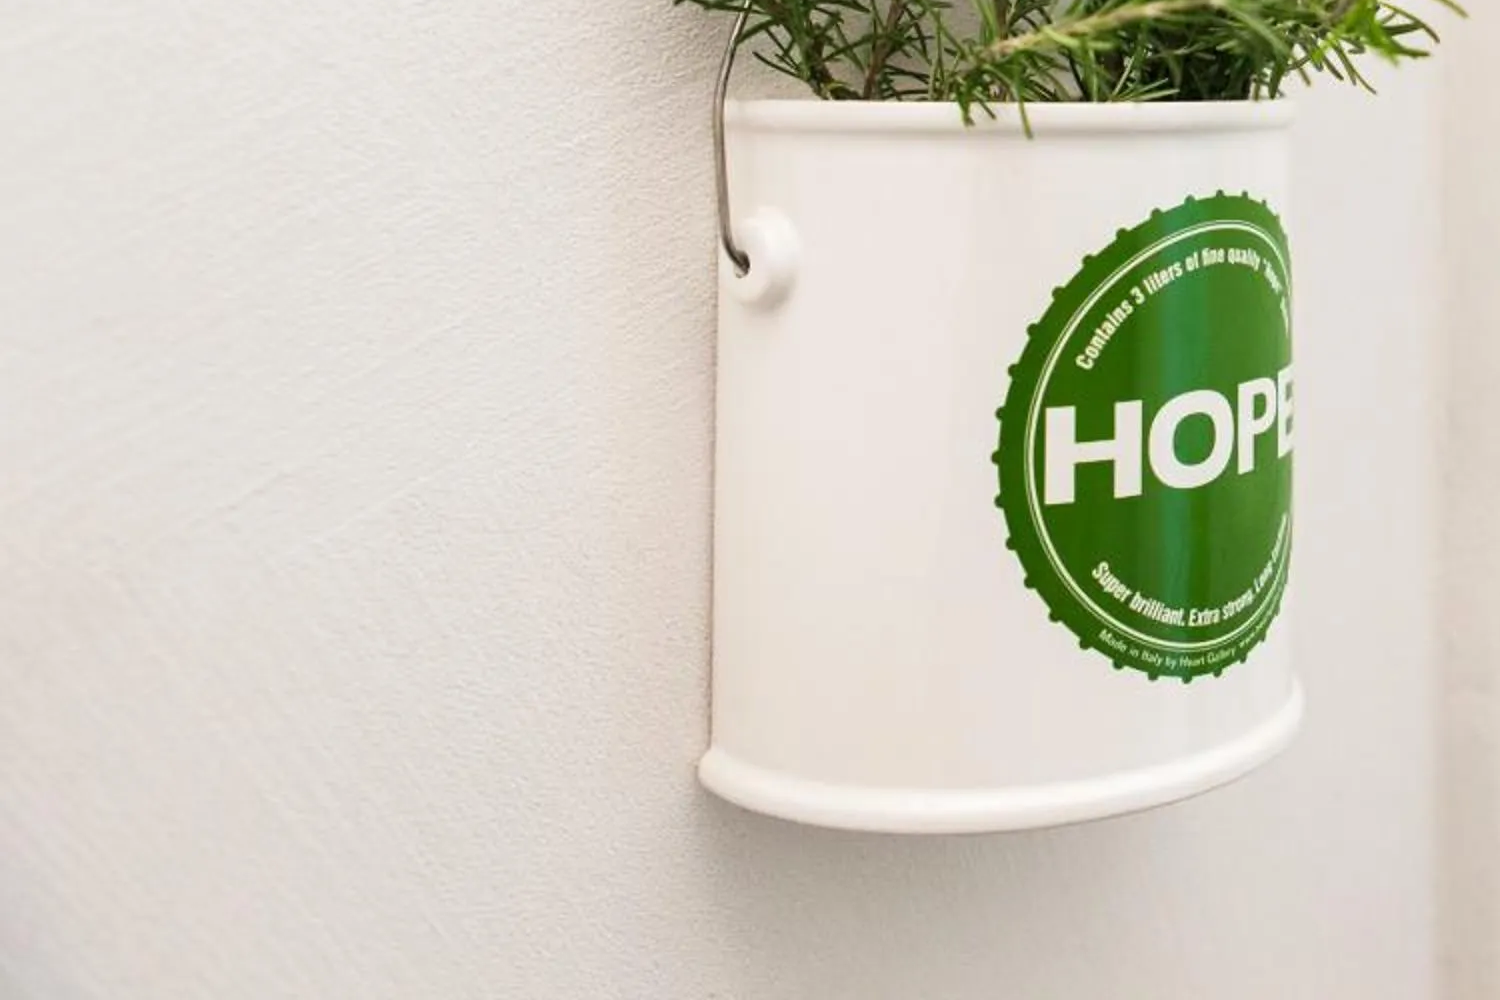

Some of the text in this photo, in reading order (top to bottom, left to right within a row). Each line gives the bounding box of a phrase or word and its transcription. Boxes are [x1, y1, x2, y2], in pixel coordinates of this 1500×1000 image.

[1075, 300, 1134, 370] Contains
[1130, 287, 1145, 305] 3
[1142, 261, 1183, 296] liters
[1185, 250, 1200, 272] of
[1201, 247, 1225, 267] fine
[1044, 363, 1293, 505] HOPE
[1091, 561, 1132, 603] Super
[1129, 591, 1185, 627] brilliant.
[1188, 608, 1220, 627] Extra
[1099, 629, 1127, 652] Made
